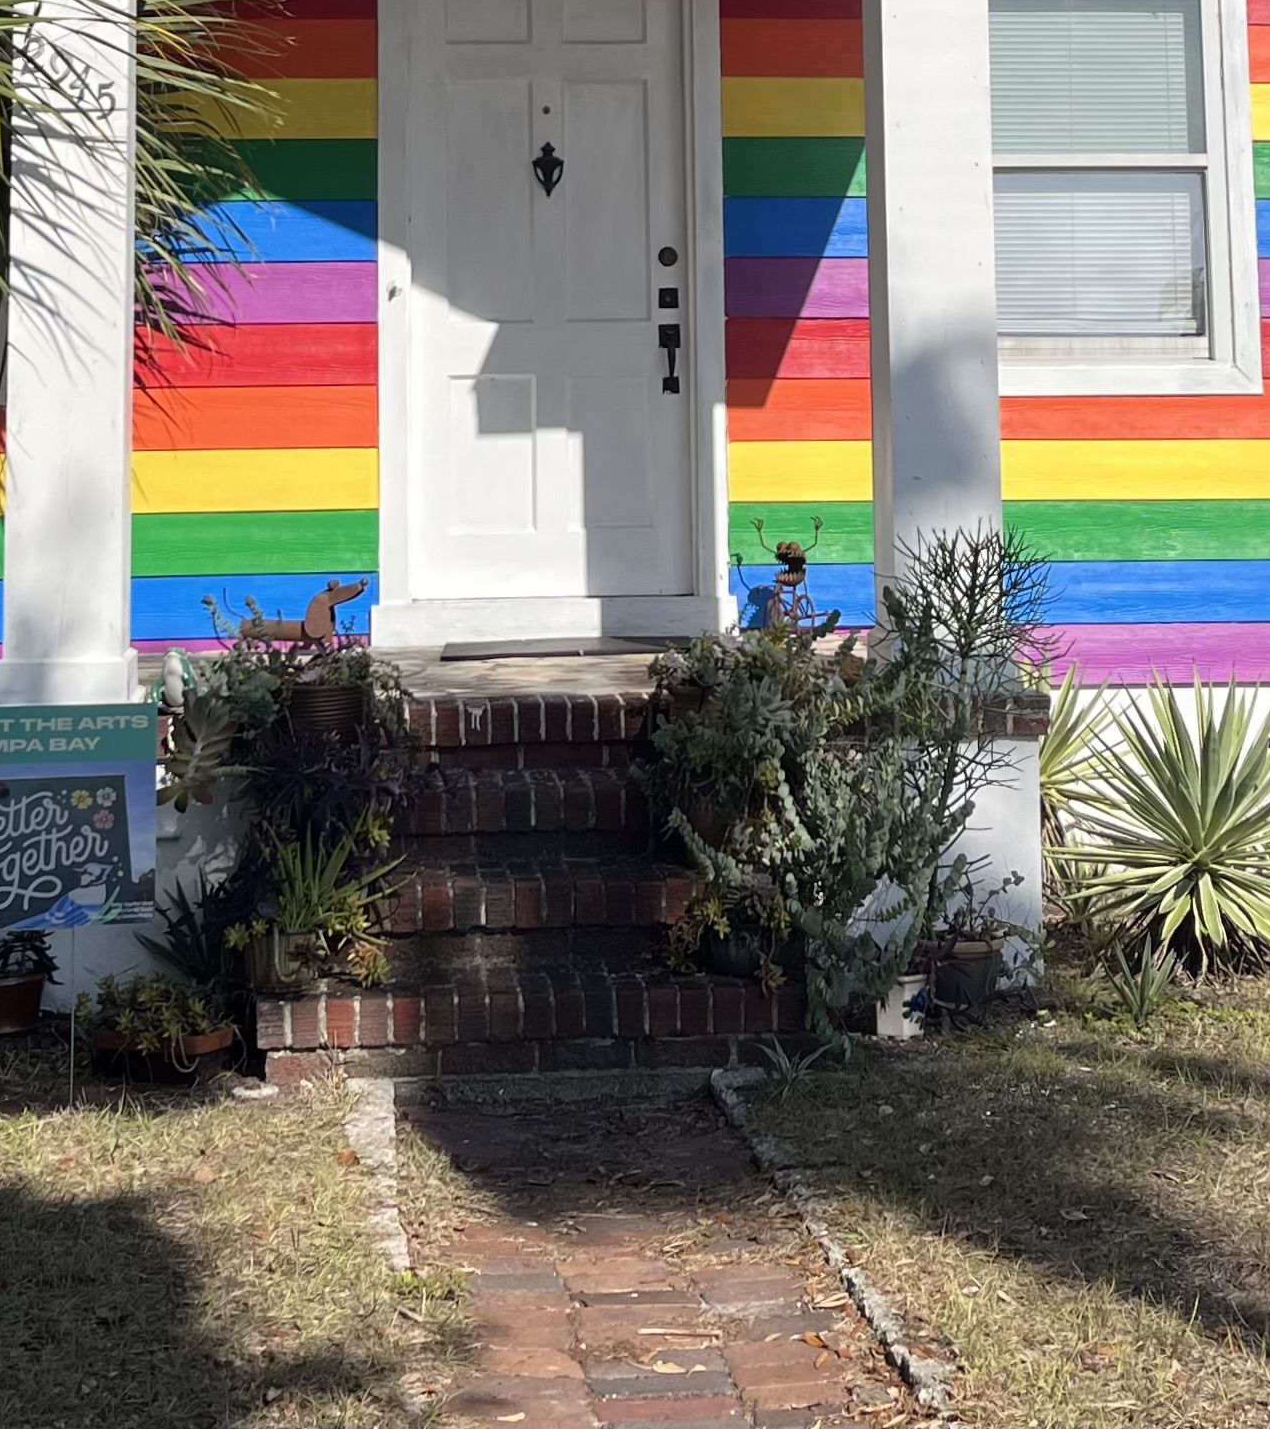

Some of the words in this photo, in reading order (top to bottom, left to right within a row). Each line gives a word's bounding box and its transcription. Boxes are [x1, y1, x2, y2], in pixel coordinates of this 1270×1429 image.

[19, 716, 74, 733] THE
[78, 714, 150, 731] ARTS
[48, 736, 101, 753] BAY
